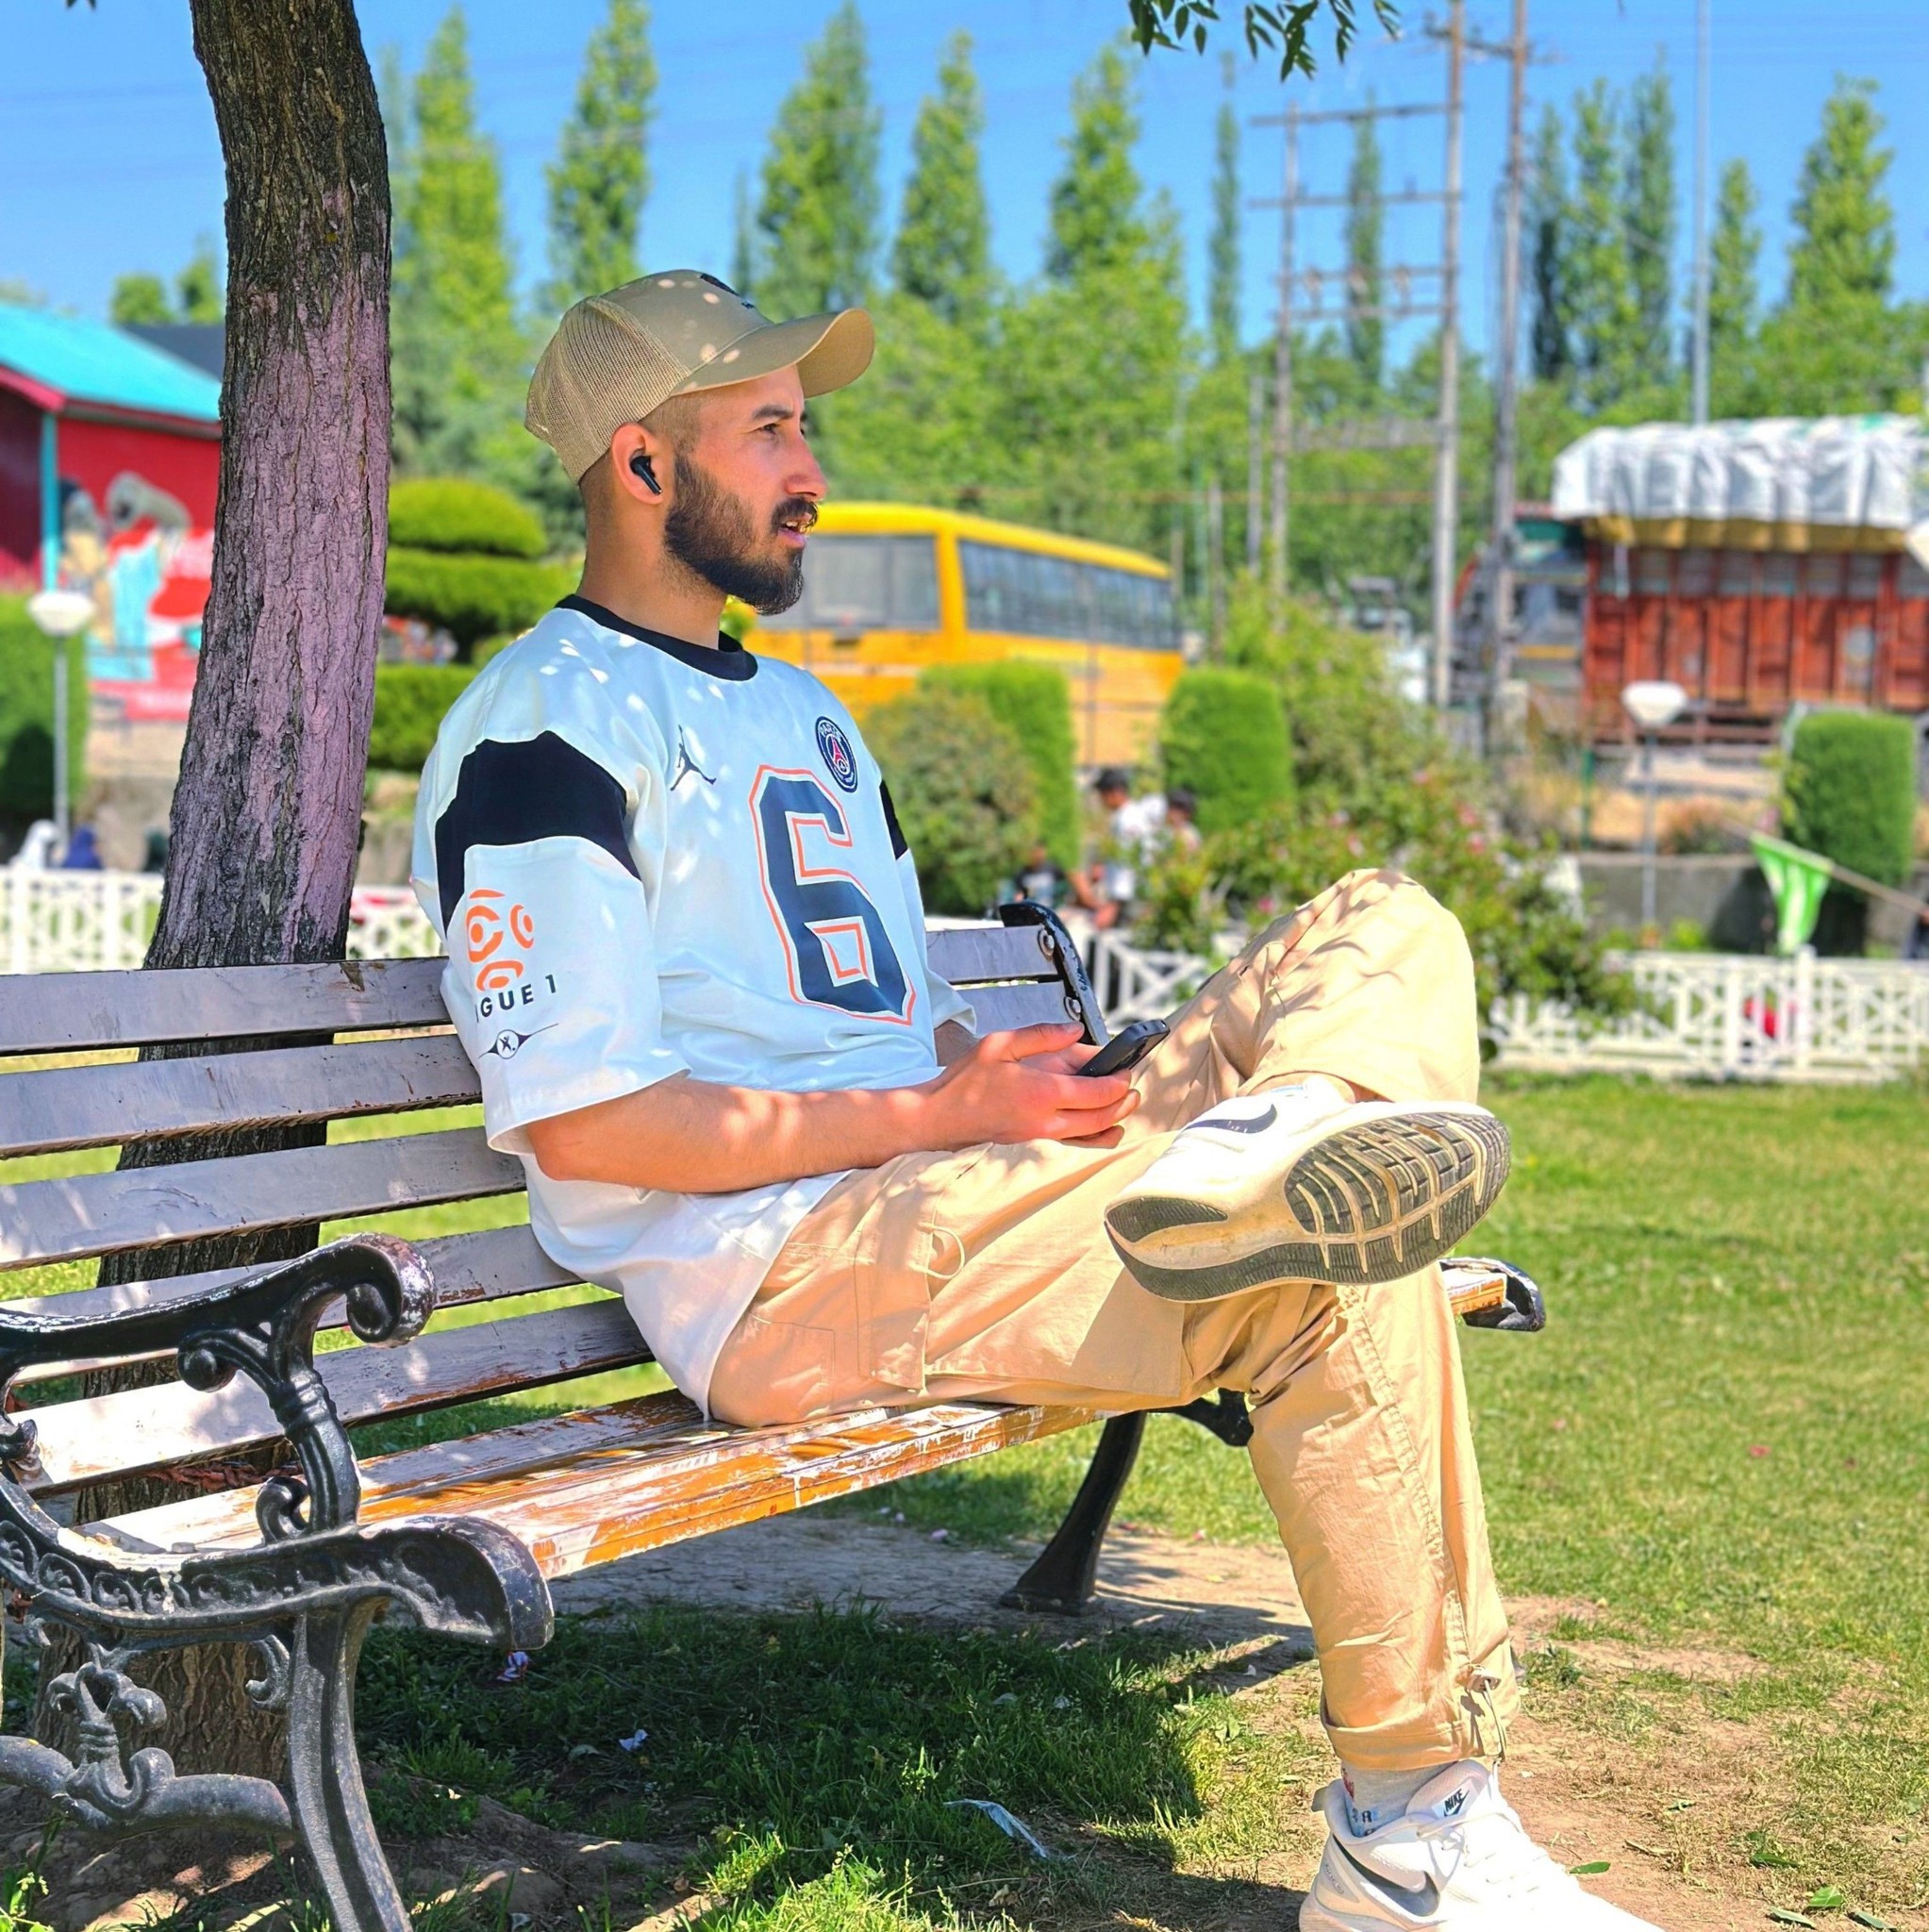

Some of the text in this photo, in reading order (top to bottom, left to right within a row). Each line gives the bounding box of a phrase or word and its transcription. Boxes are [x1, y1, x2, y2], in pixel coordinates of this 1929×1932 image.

[749, 764, 916, 1025] 6
[544, 974, 557, 994] 1
[1443, 1788, 1463, 1811] NIKE
